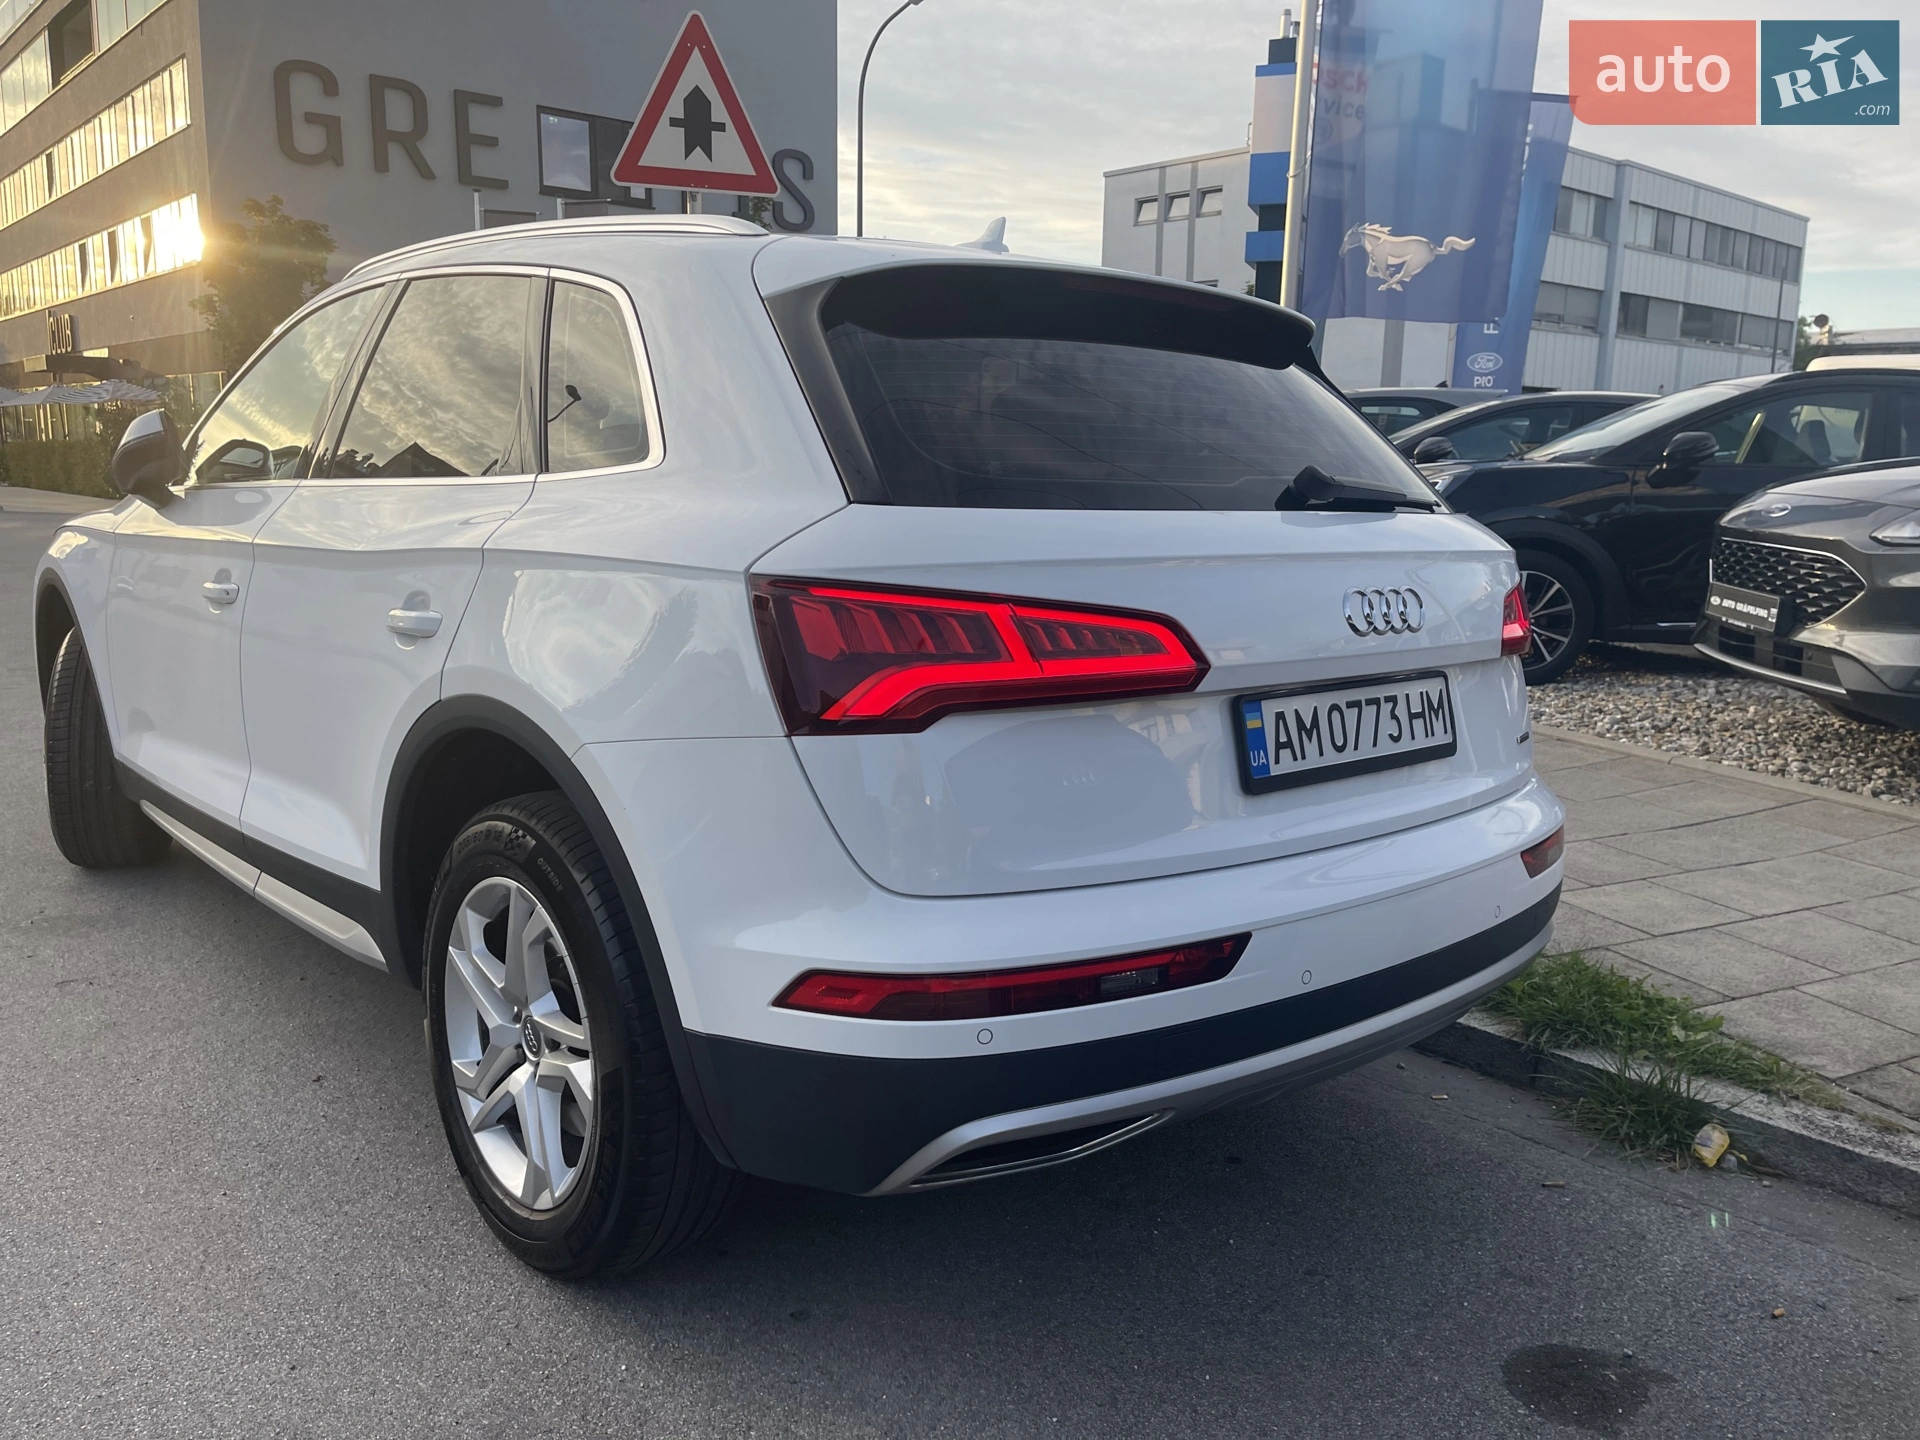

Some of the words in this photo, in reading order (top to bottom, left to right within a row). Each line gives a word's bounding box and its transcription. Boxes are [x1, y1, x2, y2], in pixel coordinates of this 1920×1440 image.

[49, 313, 73, 356] CLUB
[1250, 749, 1268, 767] UA
[537, 857, 564, 893] OUTSIDE
